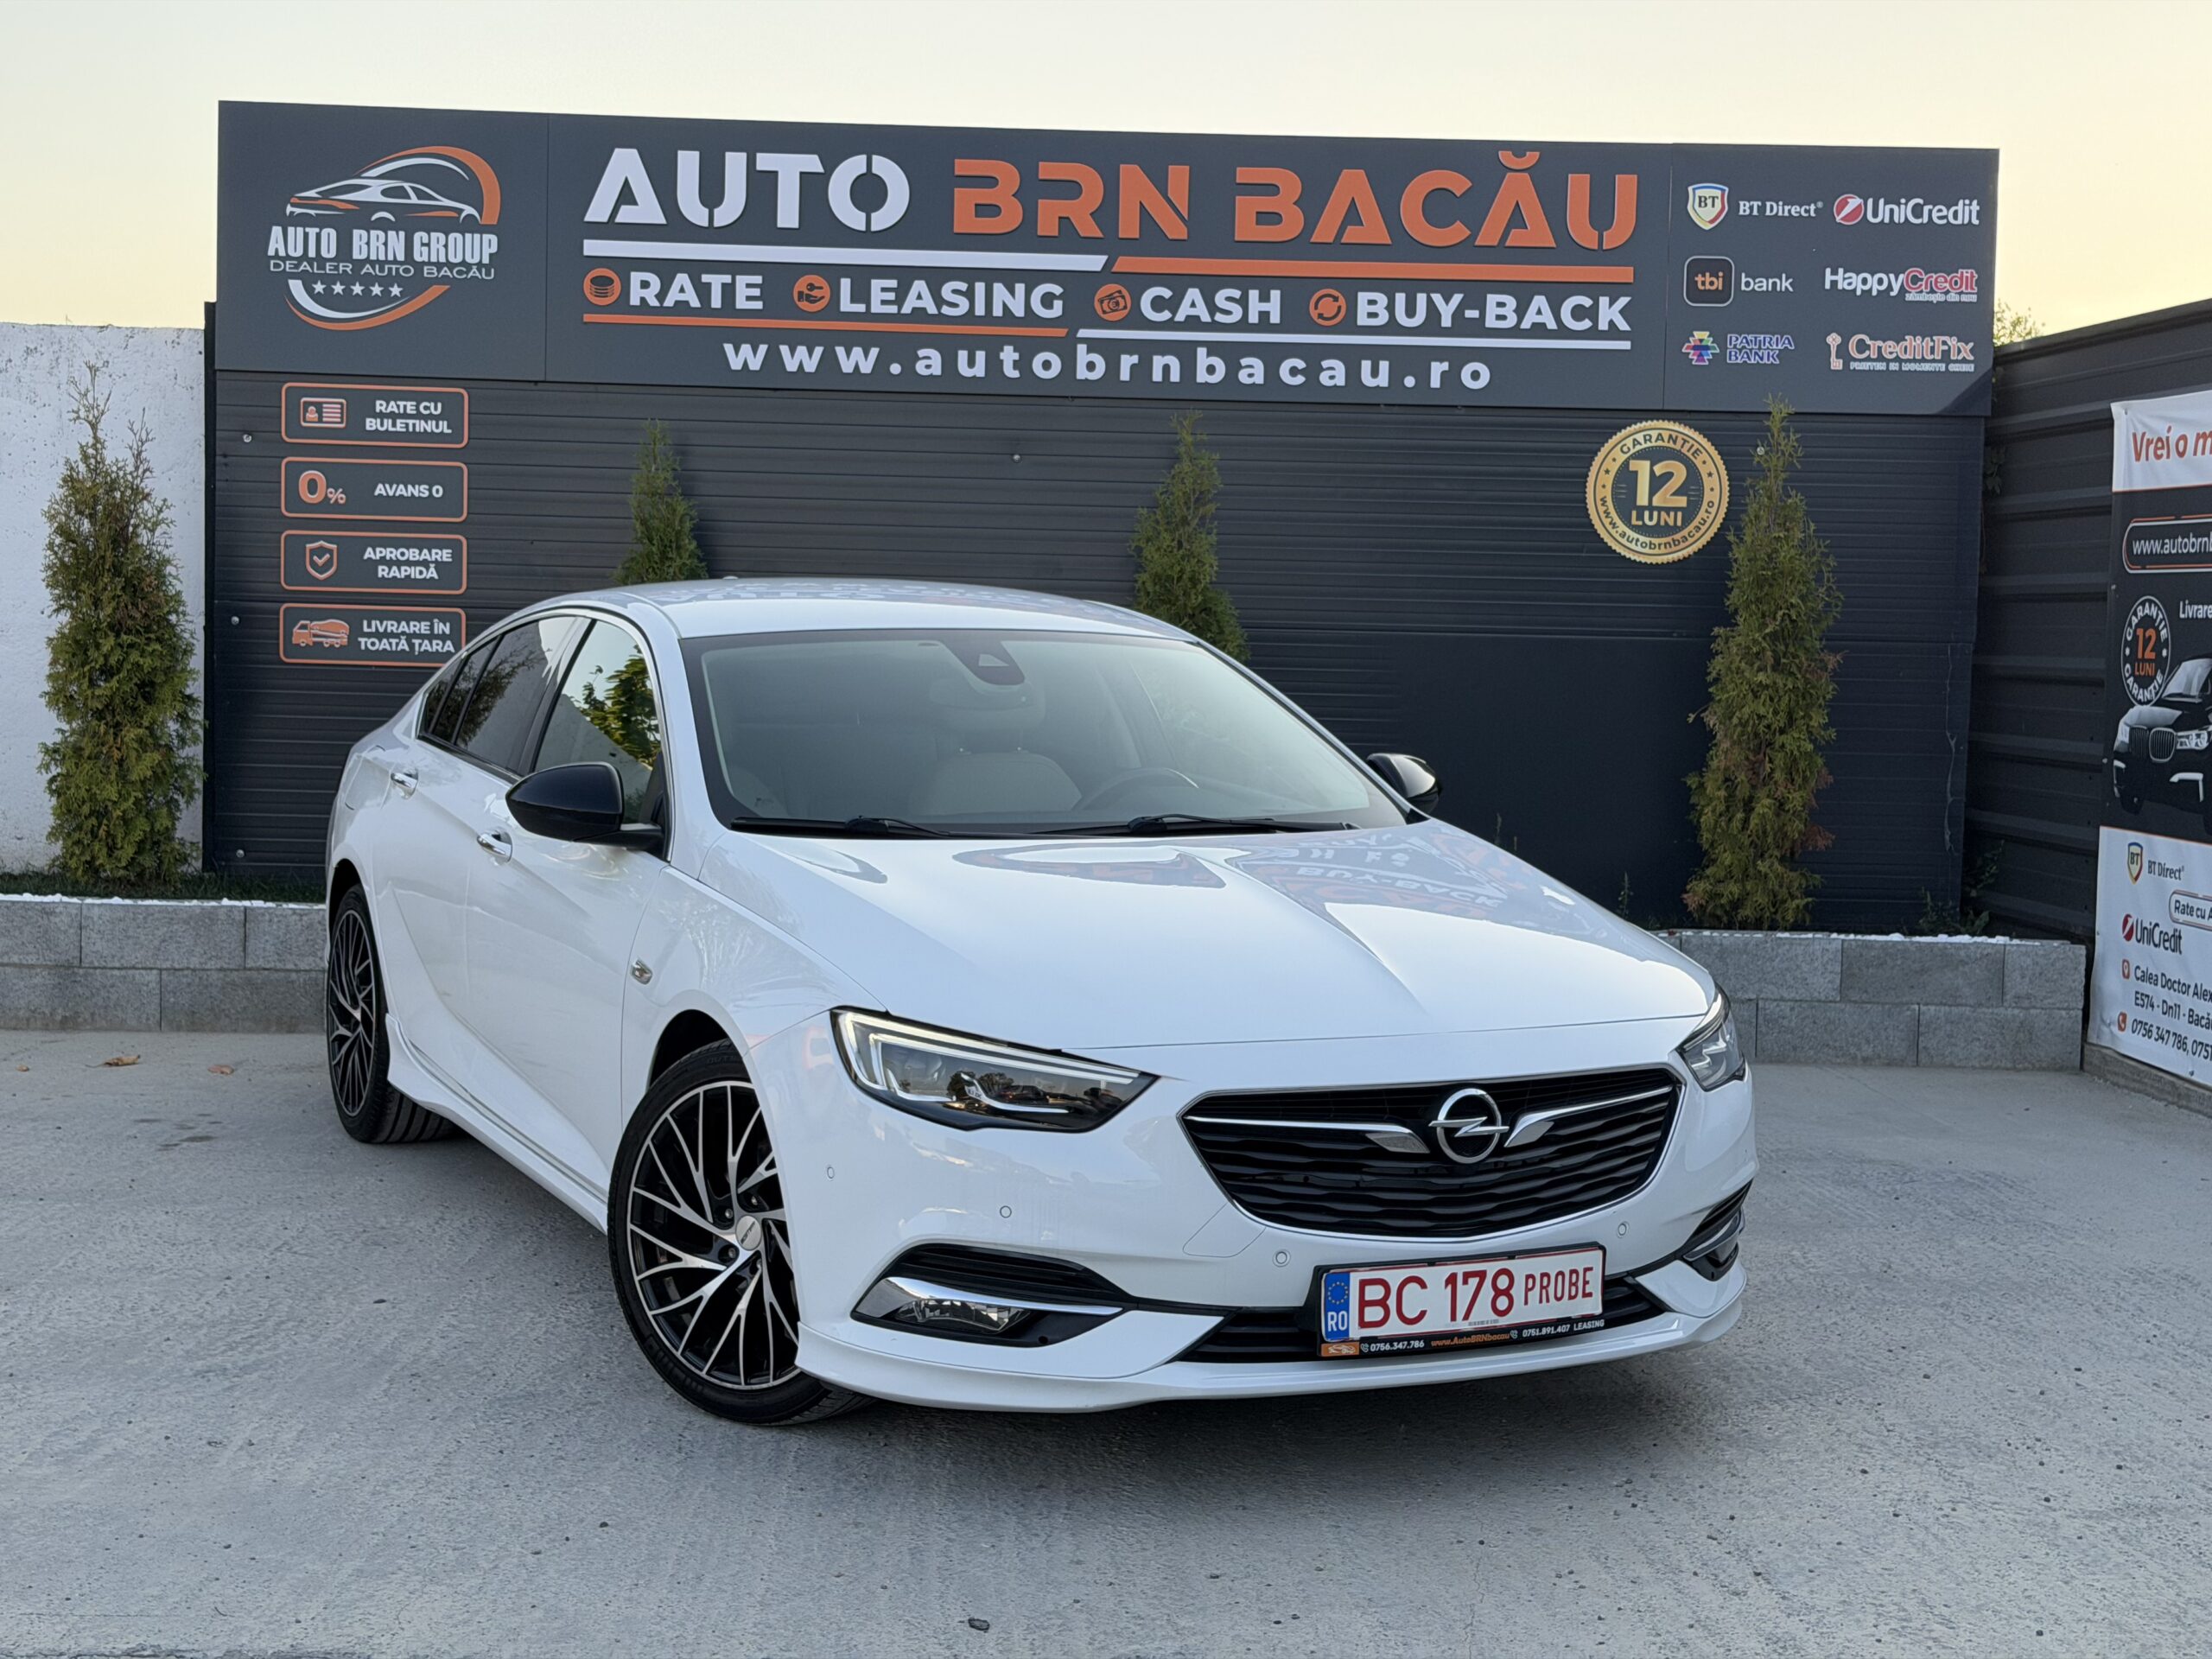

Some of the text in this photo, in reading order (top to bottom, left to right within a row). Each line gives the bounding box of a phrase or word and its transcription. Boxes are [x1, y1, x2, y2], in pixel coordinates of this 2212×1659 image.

[583, 148, 1638, 251] AUTO BRN BACĂU
[1698, 194, 1719, 208] BT
[1738, 200, 1762, 216] BT
[1866, 198, 1980, 226] UniCredit
[267, 226, 499, 264] AUTO BRN GROUP
[270, 260, 494, 280] DEALER AUTO BACĂU
[1694, 271, 1794, 292] tbi bank
[1825, 267, 1978, 296] HappyCredit
[629, 271, 1631, 332] RATE LEASING CASH BUY-BACK
[1727, 334, 1795, 349] PATRIA
[1848, 334, 1974, 360] CreditFix
[723, 342, 1491, 390] www.autobrnbacau.ro
[1726, 348, 1780, 364] BANK
[375, 400, 442, 415] RATE CU
[365, 416, 452, 434] BULETINUL
[1619, 433, 1703, 460] GARANTIE
[2132, 425, 2172, 462] Vrei
[2175, 433, 2188, 458] o
[374, 483, 429, 498] AVANS
[1629, 460, 1688, 508] 12
[1599, 495, 1715, 550] www.autobrnbacau.ro
[1631, 510, 1682, 527] LUNI
[363, 547, 453, 562] APROBARE
[2133, 531, 2212, 556] www.autobrn
[378, 563, 439, 580] RAPIDĂ
[363, 619, 450, 634] LIVRARE ÎN
[2126, 602, 2167, 642] GARANTIE
[358, 635, 410, 652] TOATĂ
[2136, 627, 2157, 659] 12
[2134, 662, 2155, 677] LUNI
[2125, 664, 2163, 702] GARANTIE
[2130, 852, 2140, 865] BT
[2147, 860, 2157, 875] BT
[2174, 899, 2194, 918] Rate
[2196, 907, 2206, 920] cu
[2135, 918, 2182, 955] UniCredit
[2134, 965, 2158, 987] Calea
[2160, 972, 2190, 996] Doctor
[2134, 990, 2154, 1012] E574
[2188, 1007, 2212, 1031] Bacă
[2132, 1019, 2153, 1039] 0756
[2154, 1026, 2171, 1046] 347
[1357, 1266, 1594, 1329] BC 178 PROBE
[1327, 1311, 1348, 1332] RO
[1370, 1340, 1425, 1352] 0756.347.786
[1522, 1325, 1571, 1338] 0751.891.407
[1573, 1319, 1605, 1332] LEASING
